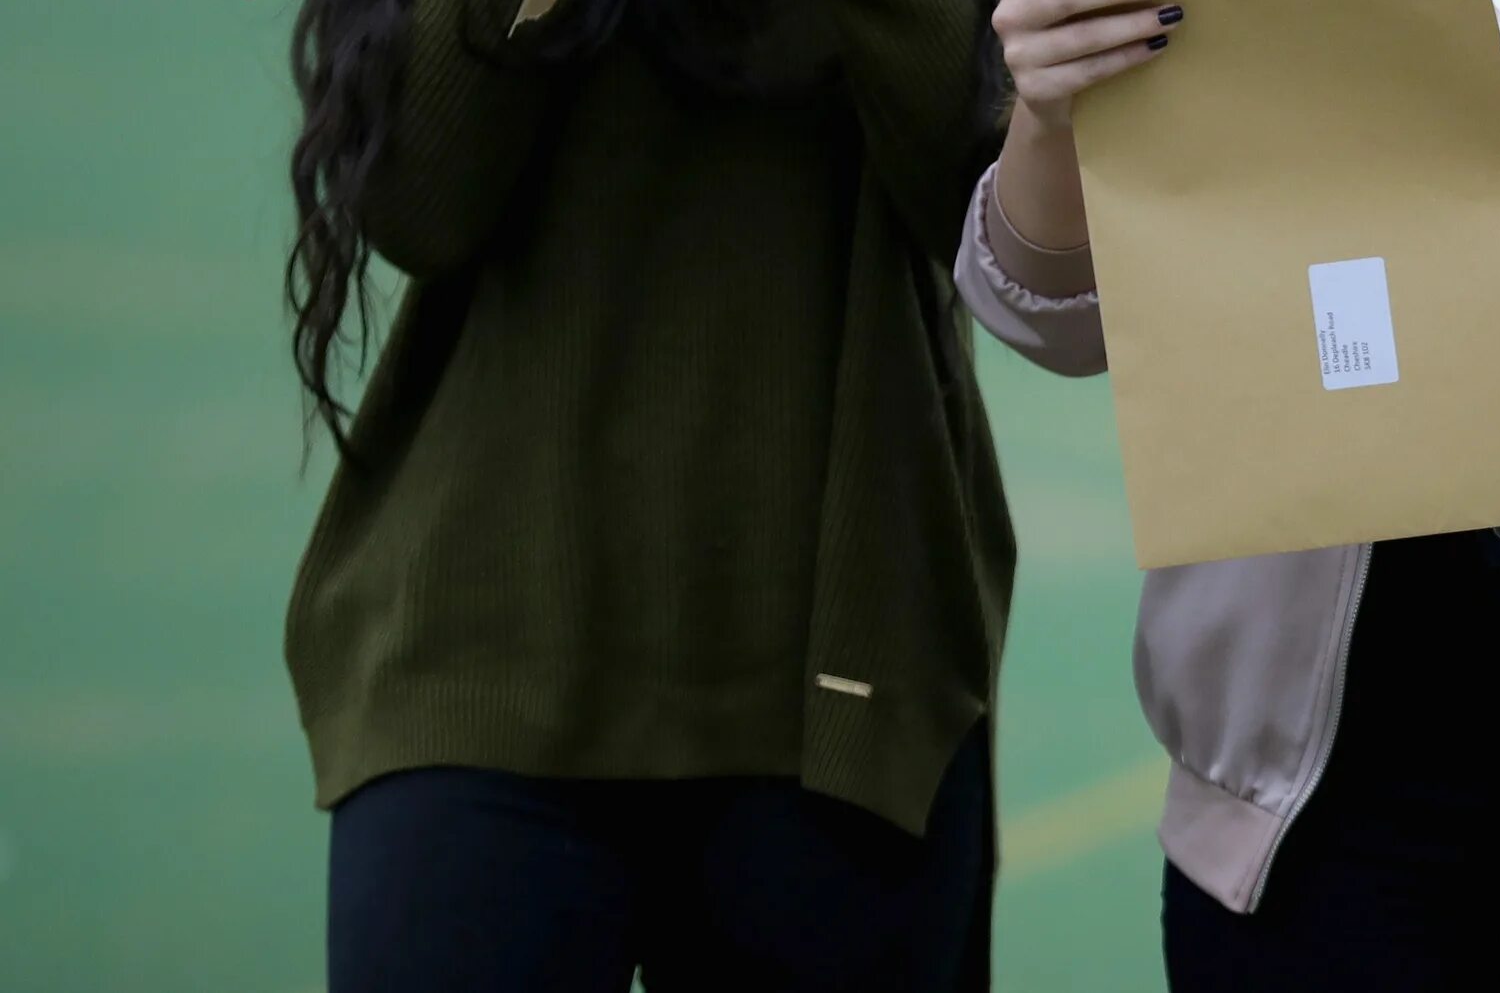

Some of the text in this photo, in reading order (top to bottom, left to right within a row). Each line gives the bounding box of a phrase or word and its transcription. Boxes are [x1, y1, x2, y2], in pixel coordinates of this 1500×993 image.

[1327, 311, 1335, 330] Road
[1341, 344, 1351, 372] Cheadle
[1352, 341, 1361, 372] Cheshire
